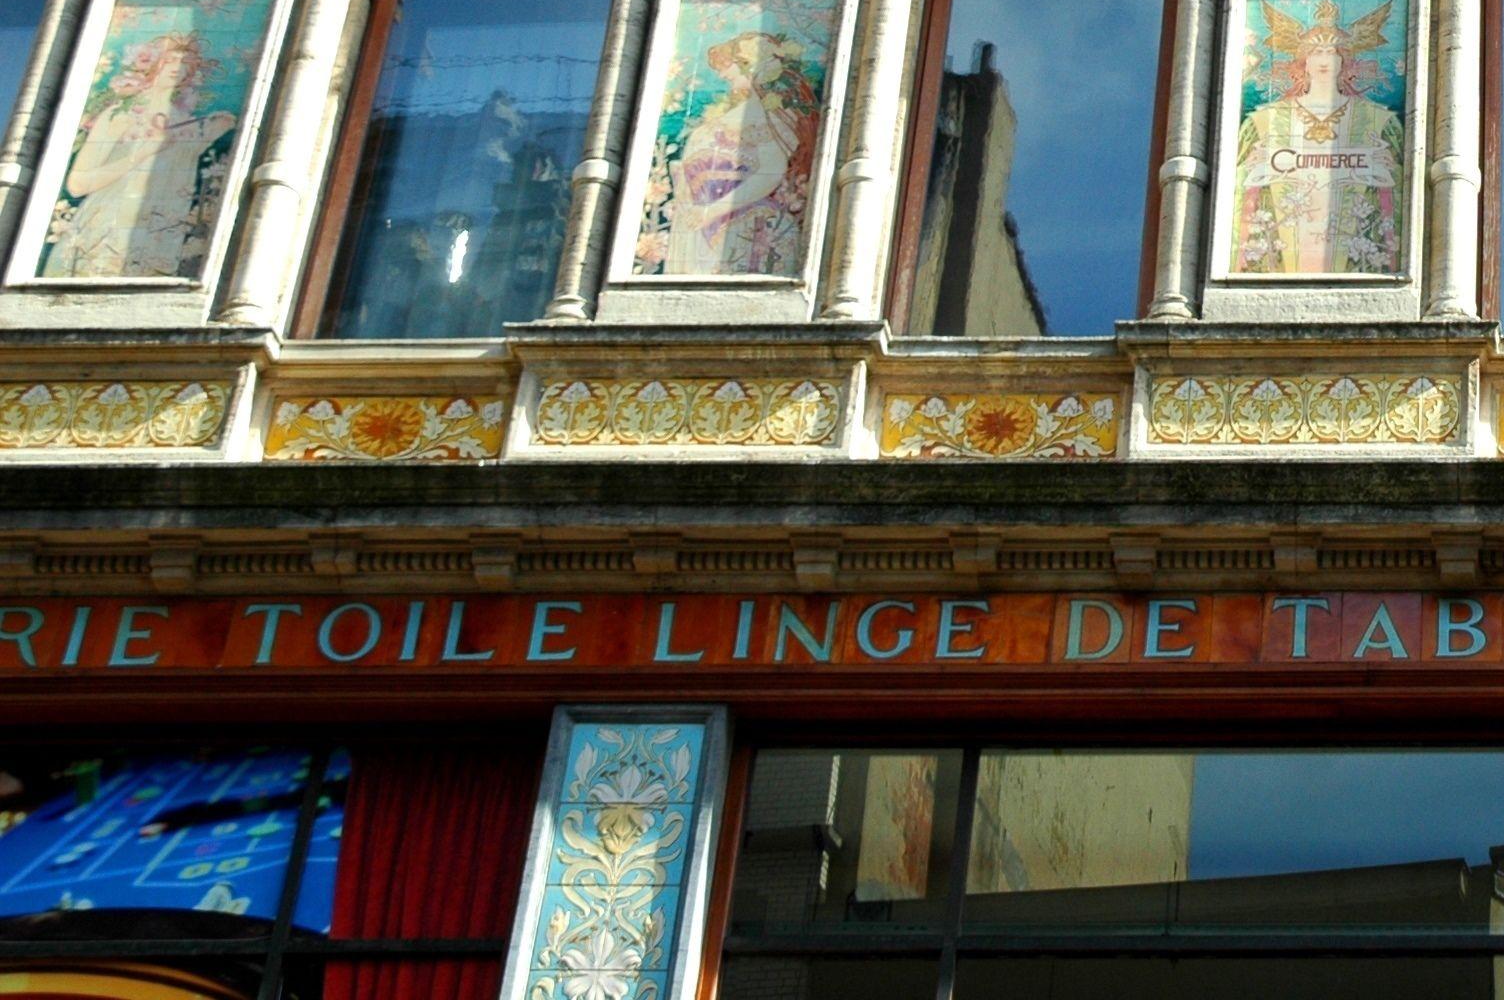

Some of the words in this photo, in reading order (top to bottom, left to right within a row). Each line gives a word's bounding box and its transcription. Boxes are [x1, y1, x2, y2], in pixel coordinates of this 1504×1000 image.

[243, 600, 584, 664] TOILE
[652, 600, 989, 662] LINGE
[1064, 599, 1197, 660] DE
